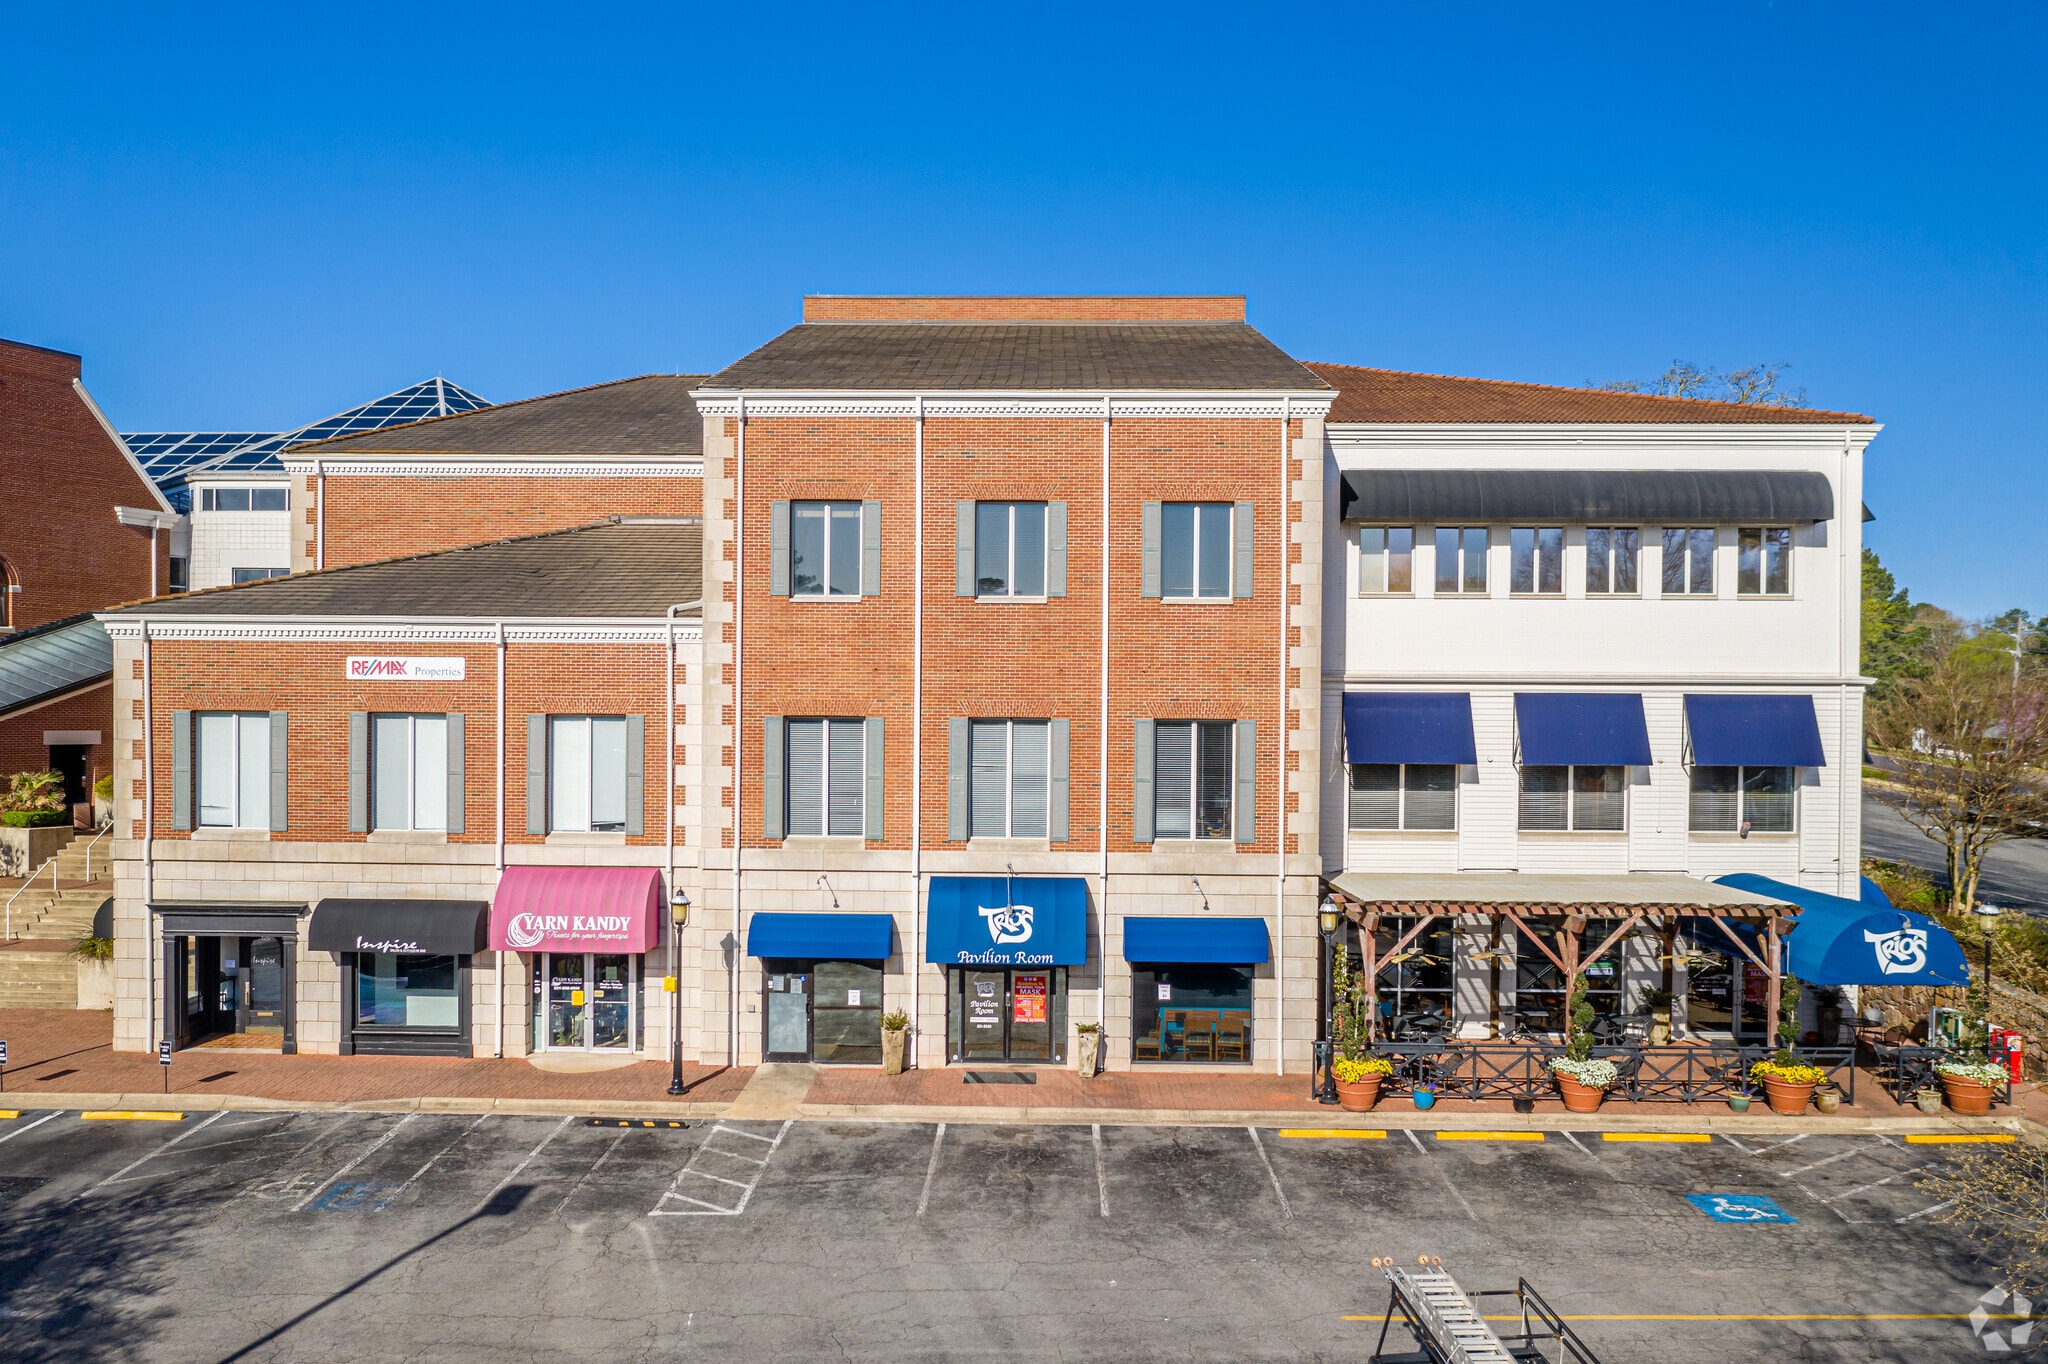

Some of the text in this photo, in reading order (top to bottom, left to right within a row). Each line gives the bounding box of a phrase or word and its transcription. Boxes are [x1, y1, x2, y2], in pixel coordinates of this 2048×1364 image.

[351, 659, 461, 677] RE/MAX Properties
[523, 915, 631, 931] YARN KANDY
[546, 930, 570, 939] Treats
[569, 932, 580, 940] for
[596, 932, 629, 940] fingertips
[356, 935, 418, 953] Inspire
[957, 948, 1054, 964] Pavilion Room
[970, 1000, 999, 1008] Pavilion
[975, 1007, 994, 1015] Room
